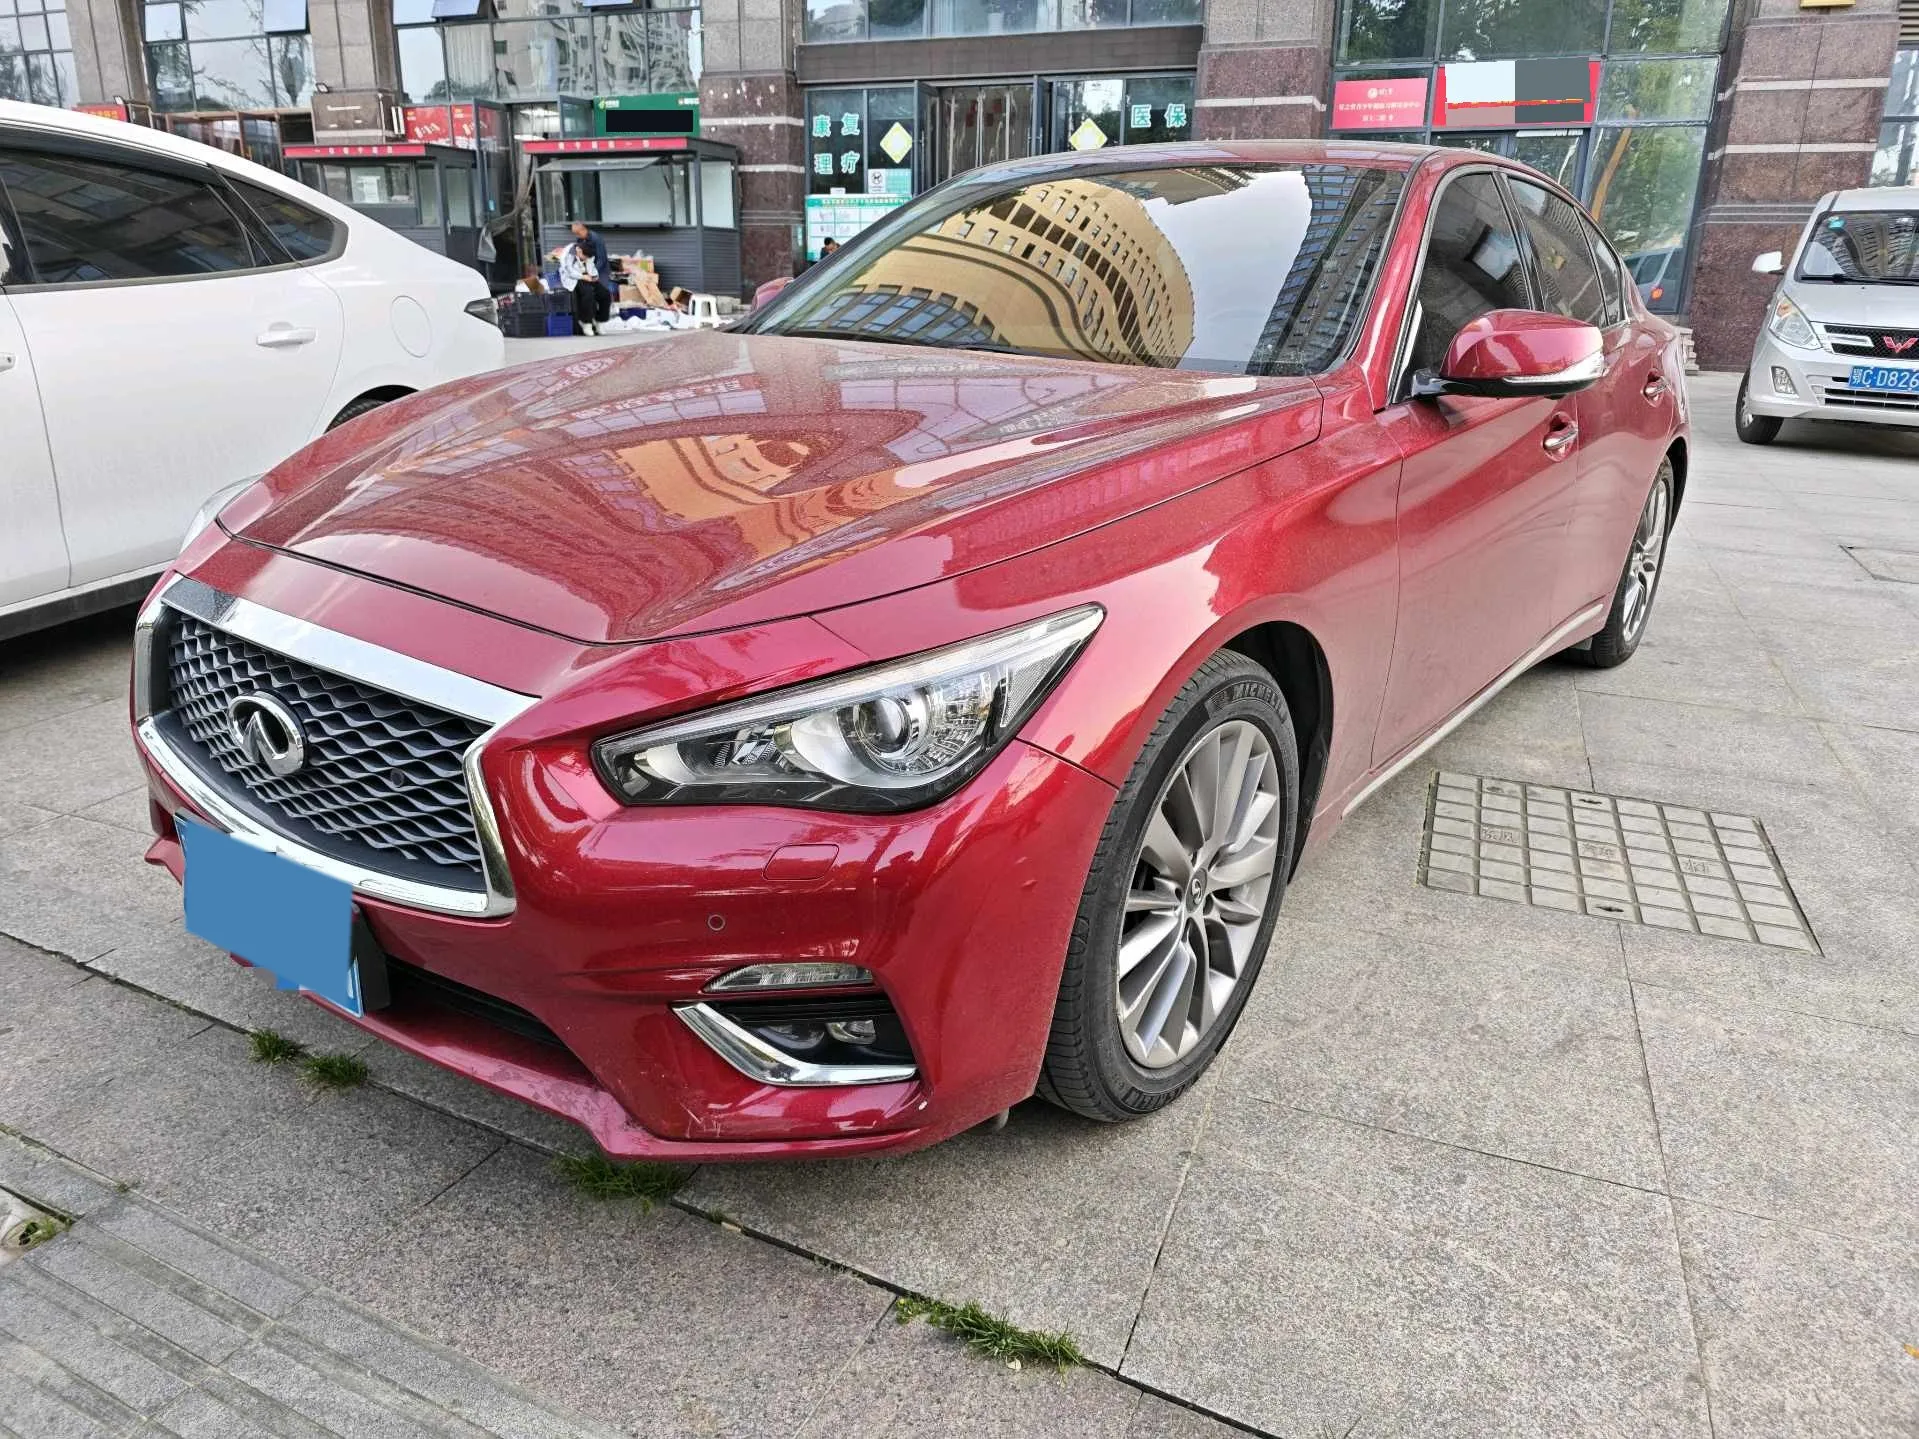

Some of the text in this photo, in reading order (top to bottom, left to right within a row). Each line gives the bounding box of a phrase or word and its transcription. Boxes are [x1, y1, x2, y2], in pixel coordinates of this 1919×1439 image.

[813, 112, 860, 137] 康复
[1131, 103, 1187, 128] 医保
[814, 151, 860, 174] 理疗
